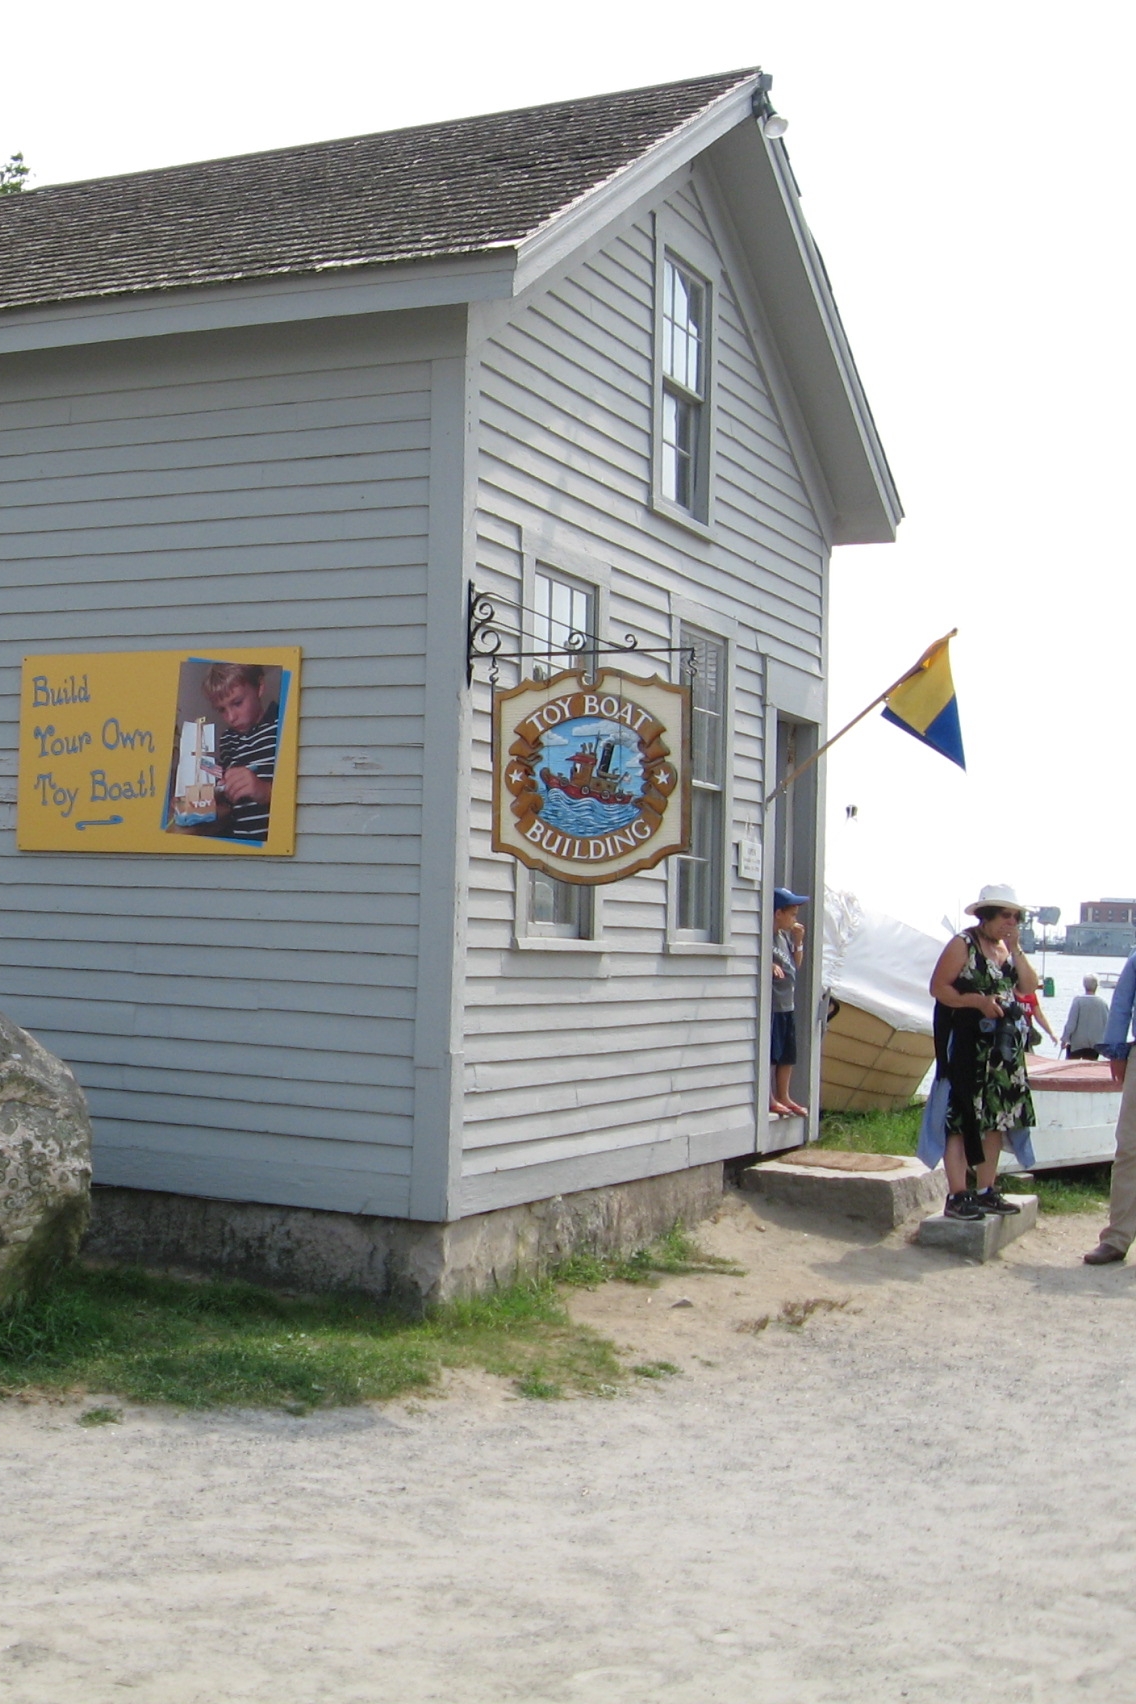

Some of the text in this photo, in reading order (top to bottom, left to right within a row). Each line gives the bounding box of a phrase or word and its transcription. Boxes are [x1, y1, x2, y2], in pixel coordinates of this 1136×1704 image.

[32, 674, 90, 707] Build
[525, 694, 652, 732] TOY BOAT
[33, 717, 155, 757] Your Own
[33, 765, 156, 817] Toy Boat!
[192, 799, 212, 808] TOY
[525, 818, 652, 860] BUILDING
